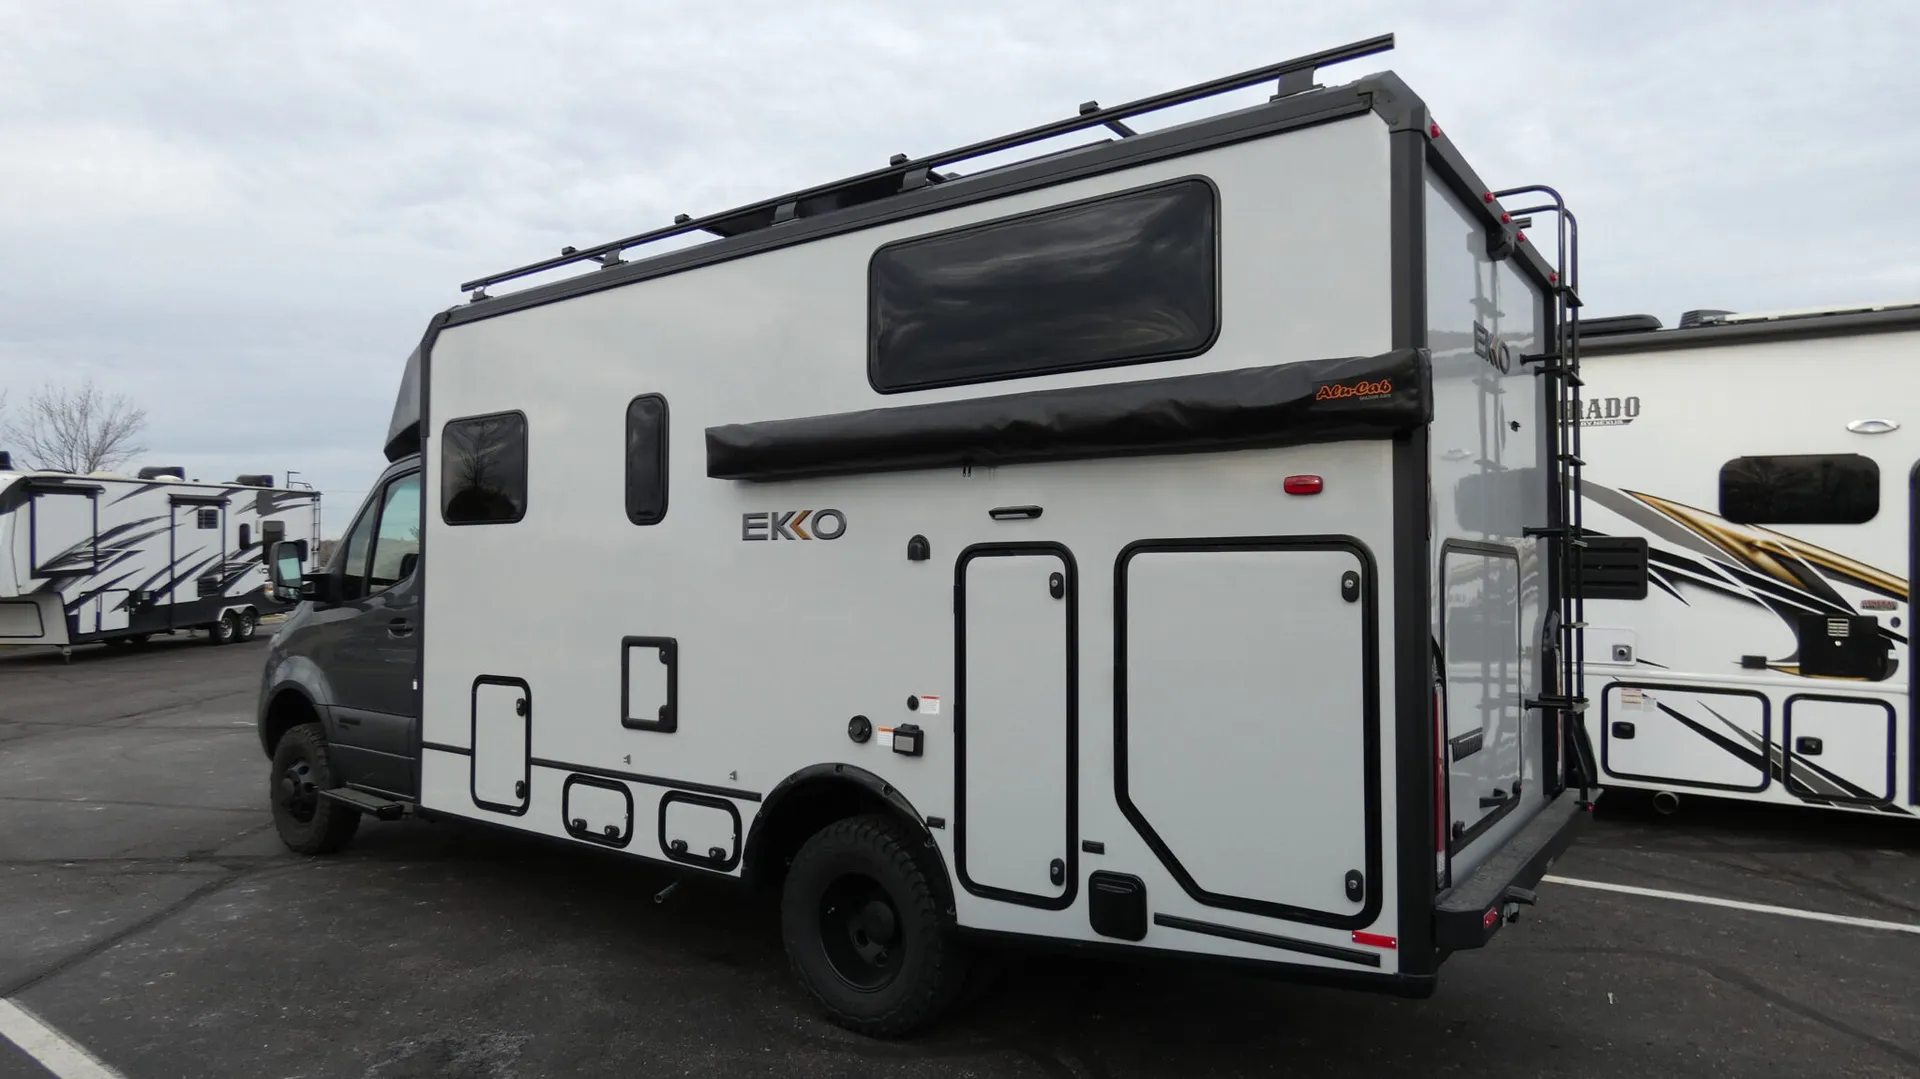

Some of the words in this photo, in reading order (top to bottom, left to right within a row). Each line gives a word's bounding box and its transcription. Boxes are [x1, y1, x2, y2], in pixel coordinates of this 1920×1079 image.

[1316, 379, 1392, 400] Alu-Cab
[1557, 396, 1641, 420] RADO
[742, 508, 847, 541] EKKO
